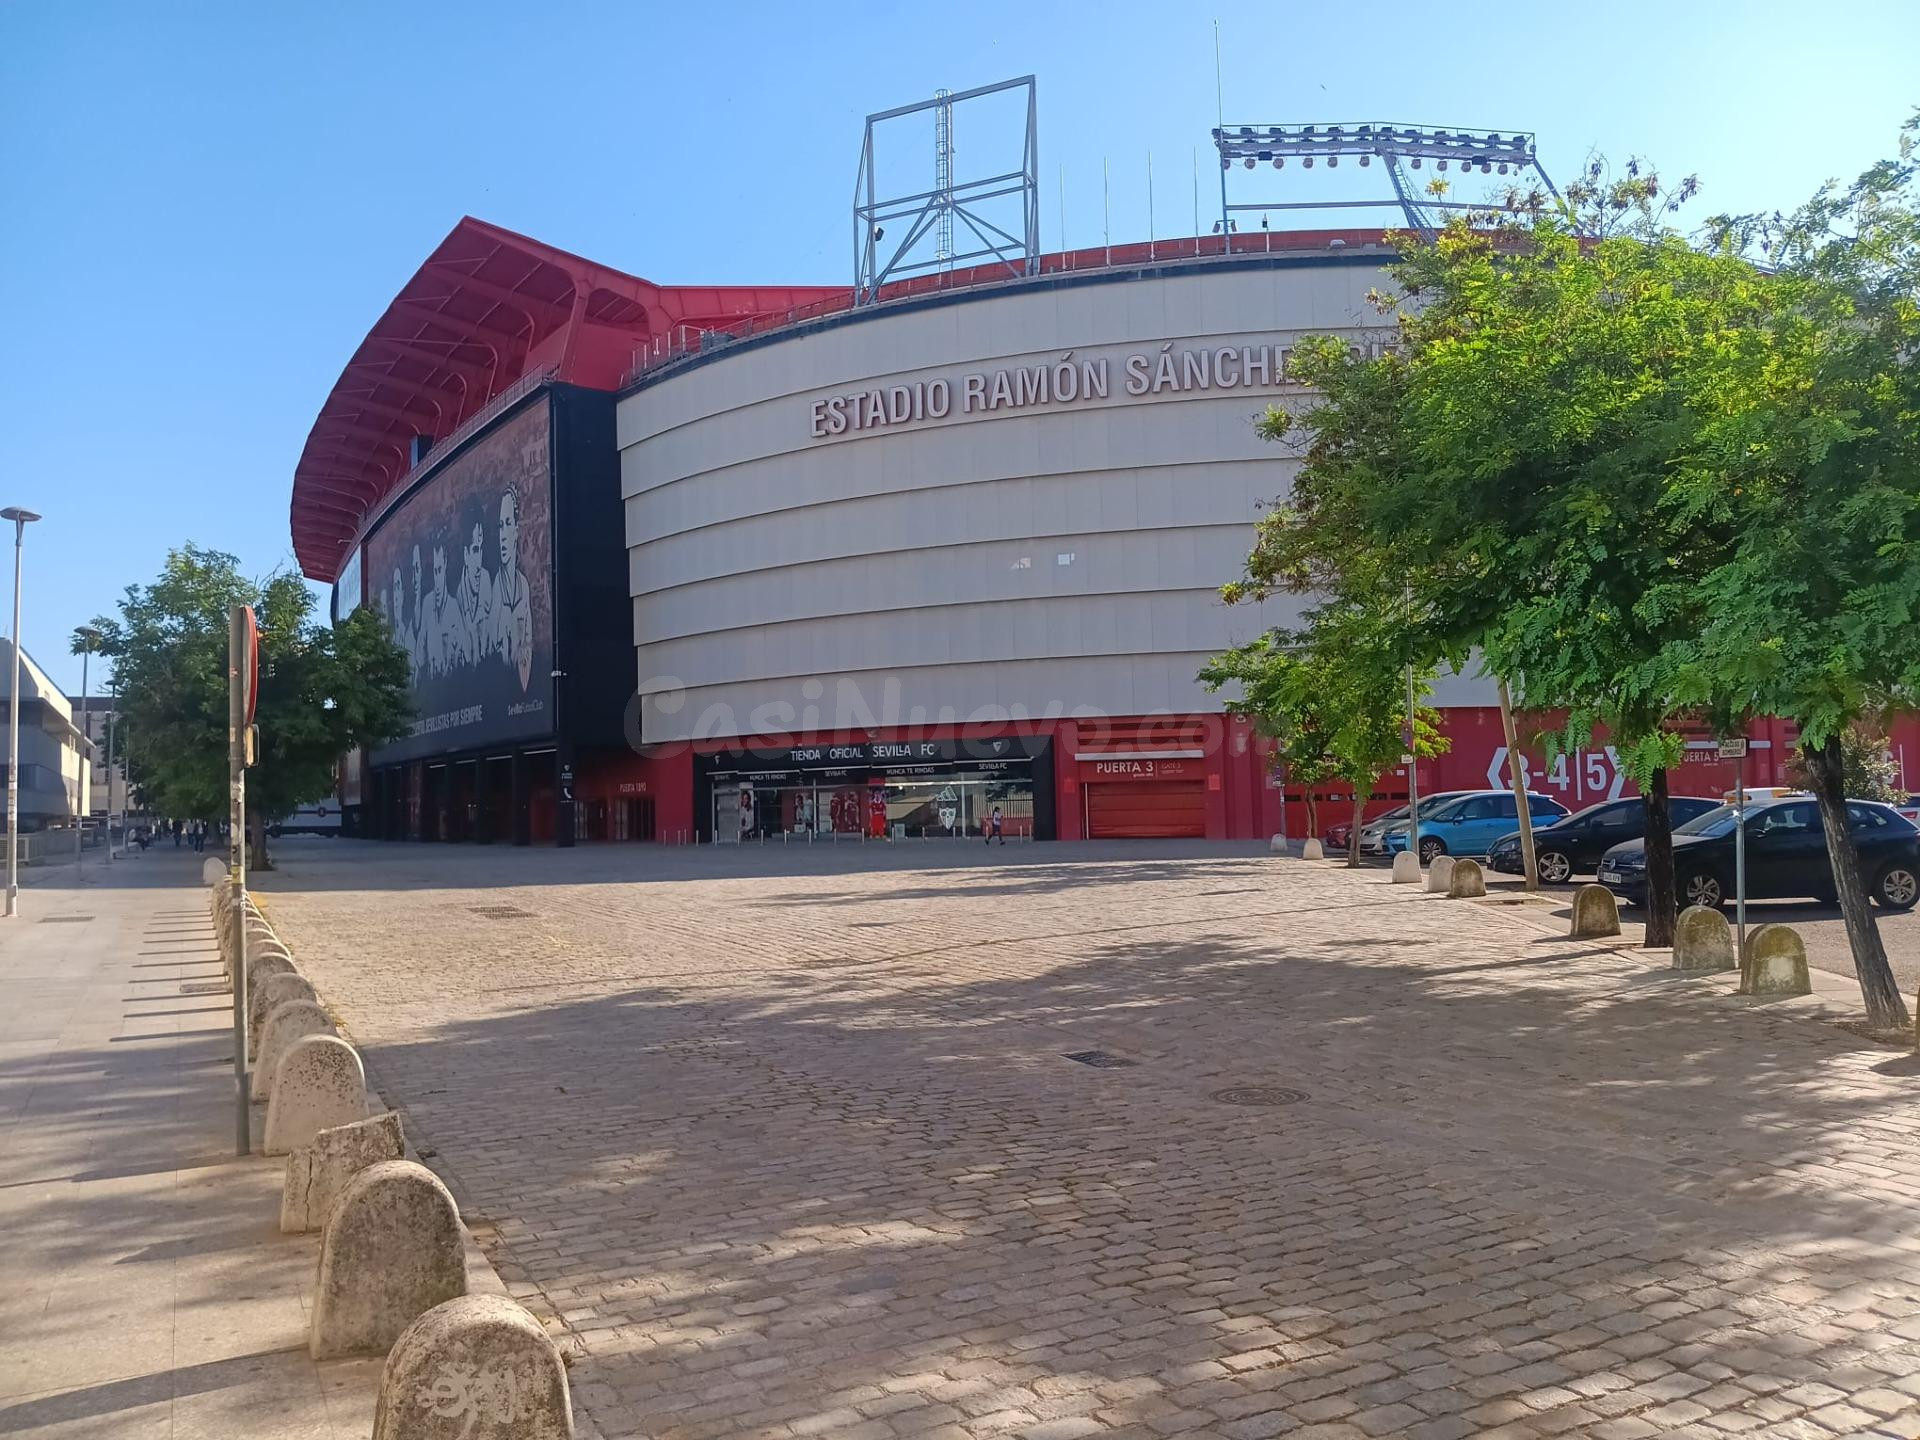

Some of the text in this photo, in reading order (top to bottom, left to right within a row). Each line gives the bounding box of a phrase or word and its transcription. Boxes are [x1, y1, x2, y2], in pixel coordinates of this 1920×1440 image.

[810, 342, 1310, 438] ESTADIO RAMÓN SÁNCHE
[791, 743, 934, 761] TIENDA OFICIAL SEVILLA FC
[1096, 761, 1154, 773] PUERTA 3
[1587, 753, 1607, 790] 5
